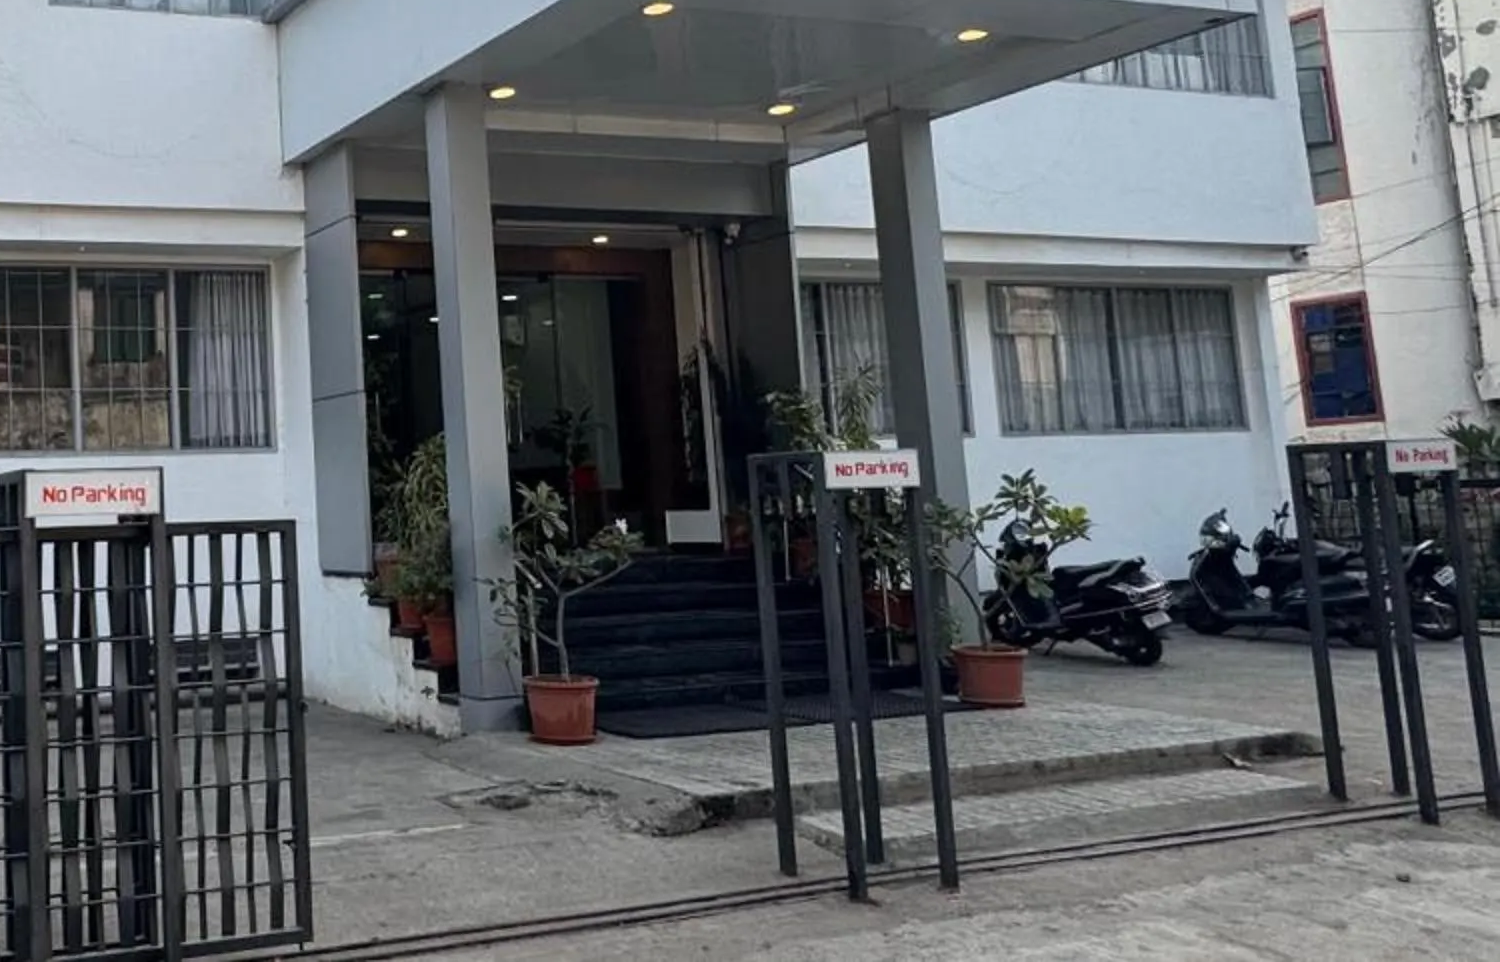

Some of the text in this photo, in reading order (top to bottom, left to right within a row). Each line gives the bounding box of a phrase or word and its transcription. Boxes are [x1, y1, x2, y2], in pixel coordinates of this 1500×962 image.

[835, 459, 909, 477] No Parking
[42, 483, 146, 506] No Parking
